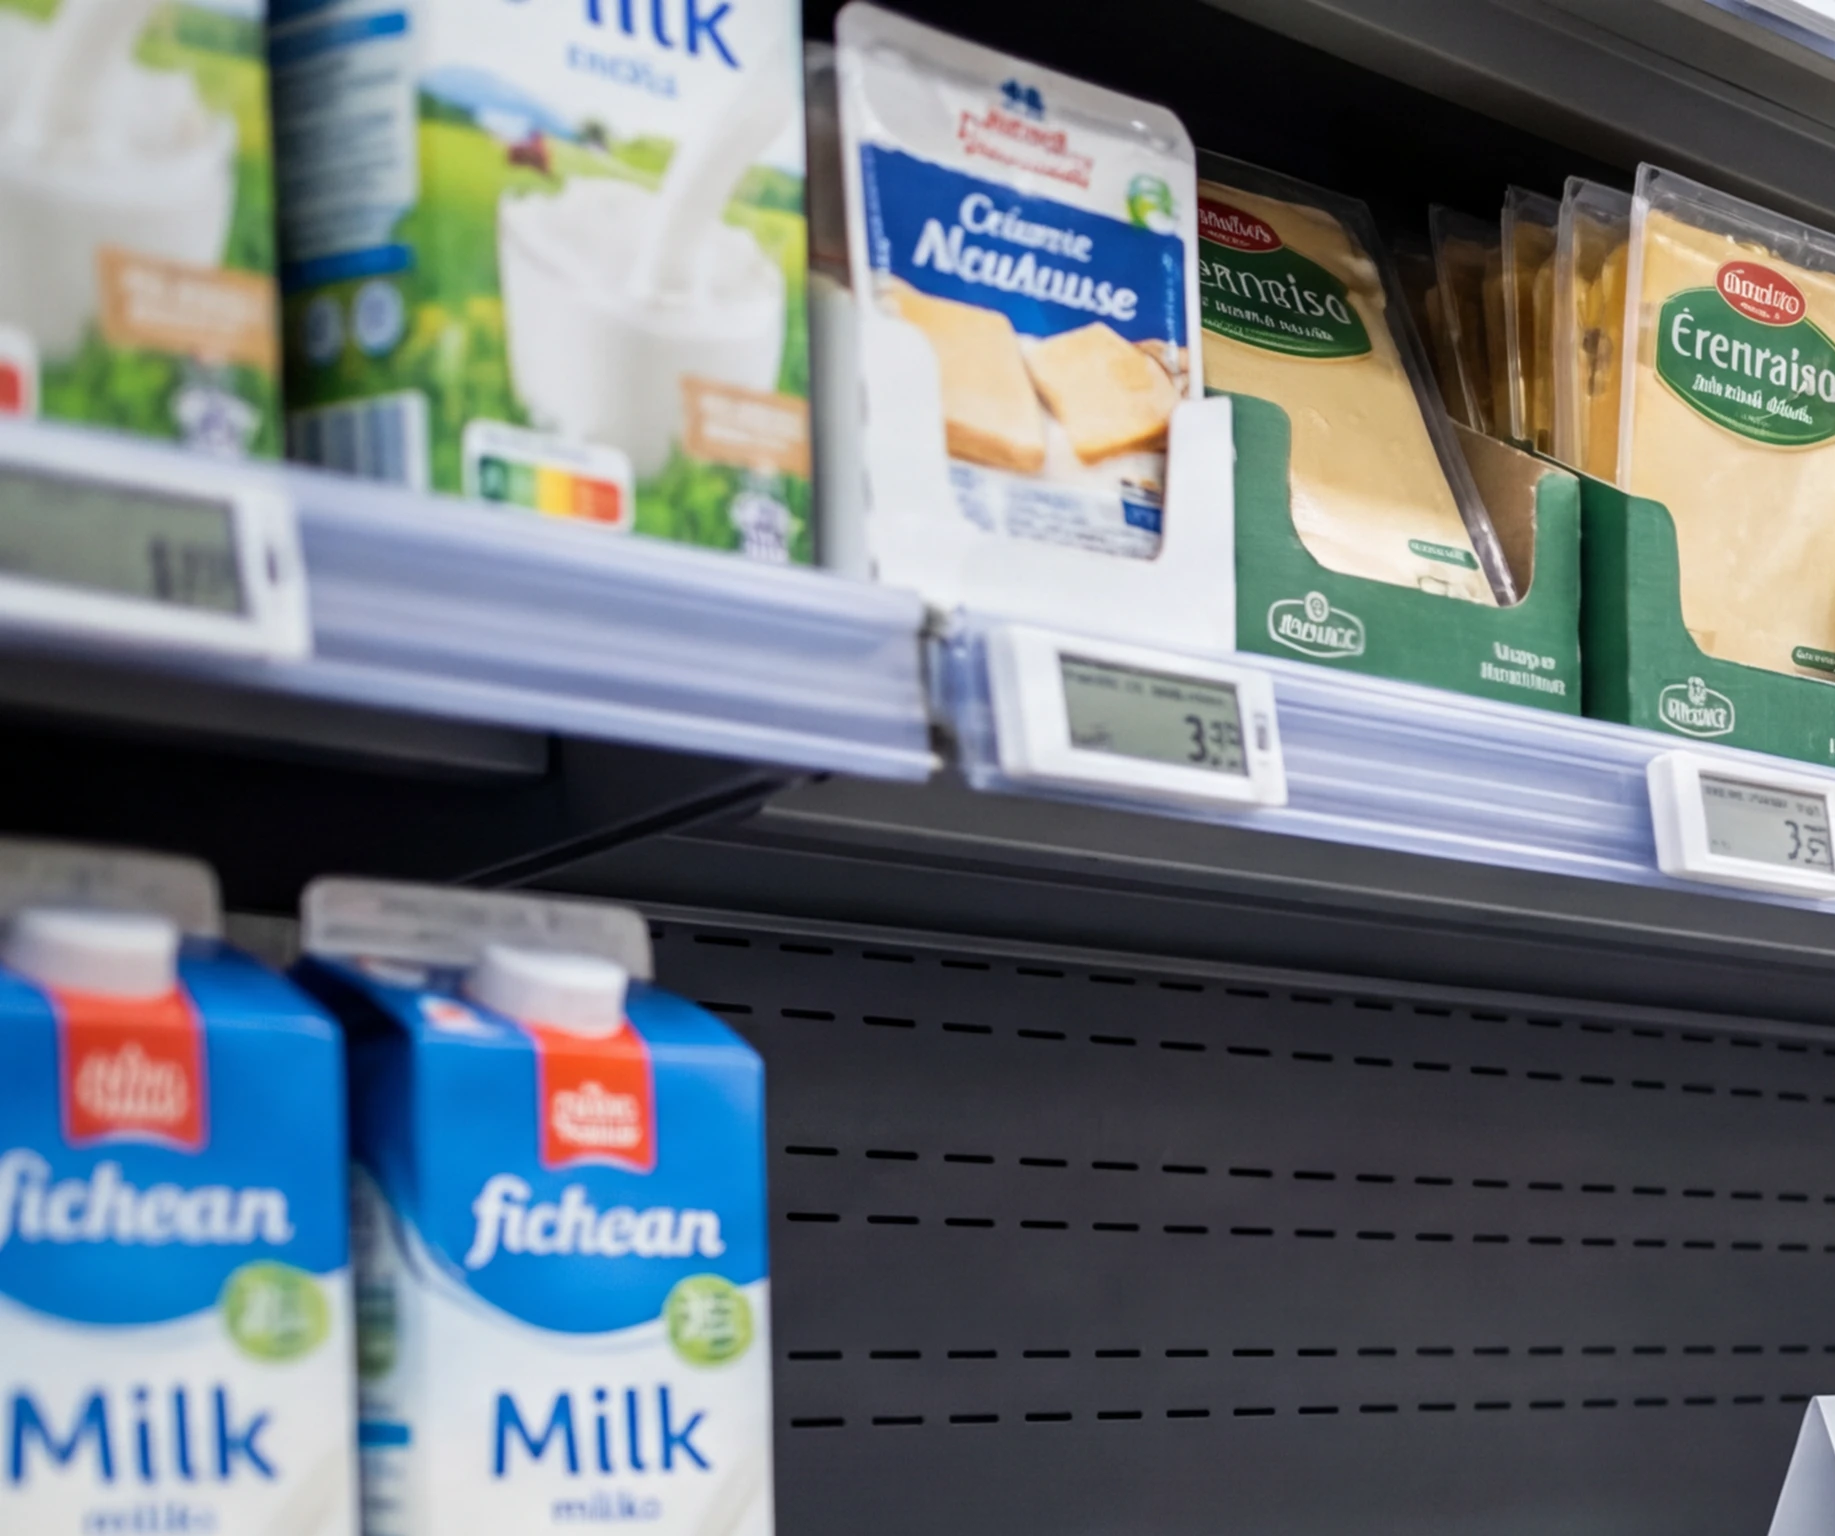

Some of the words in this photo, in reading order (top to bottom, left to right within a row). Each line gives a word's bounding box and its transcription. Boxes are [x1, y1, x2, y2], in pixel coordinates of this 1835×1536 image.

[464, 1173, 726, 1268] fichean
[8, 1384, 279, 1487] Milk
[489, 1383, 715, 1479] Milk
